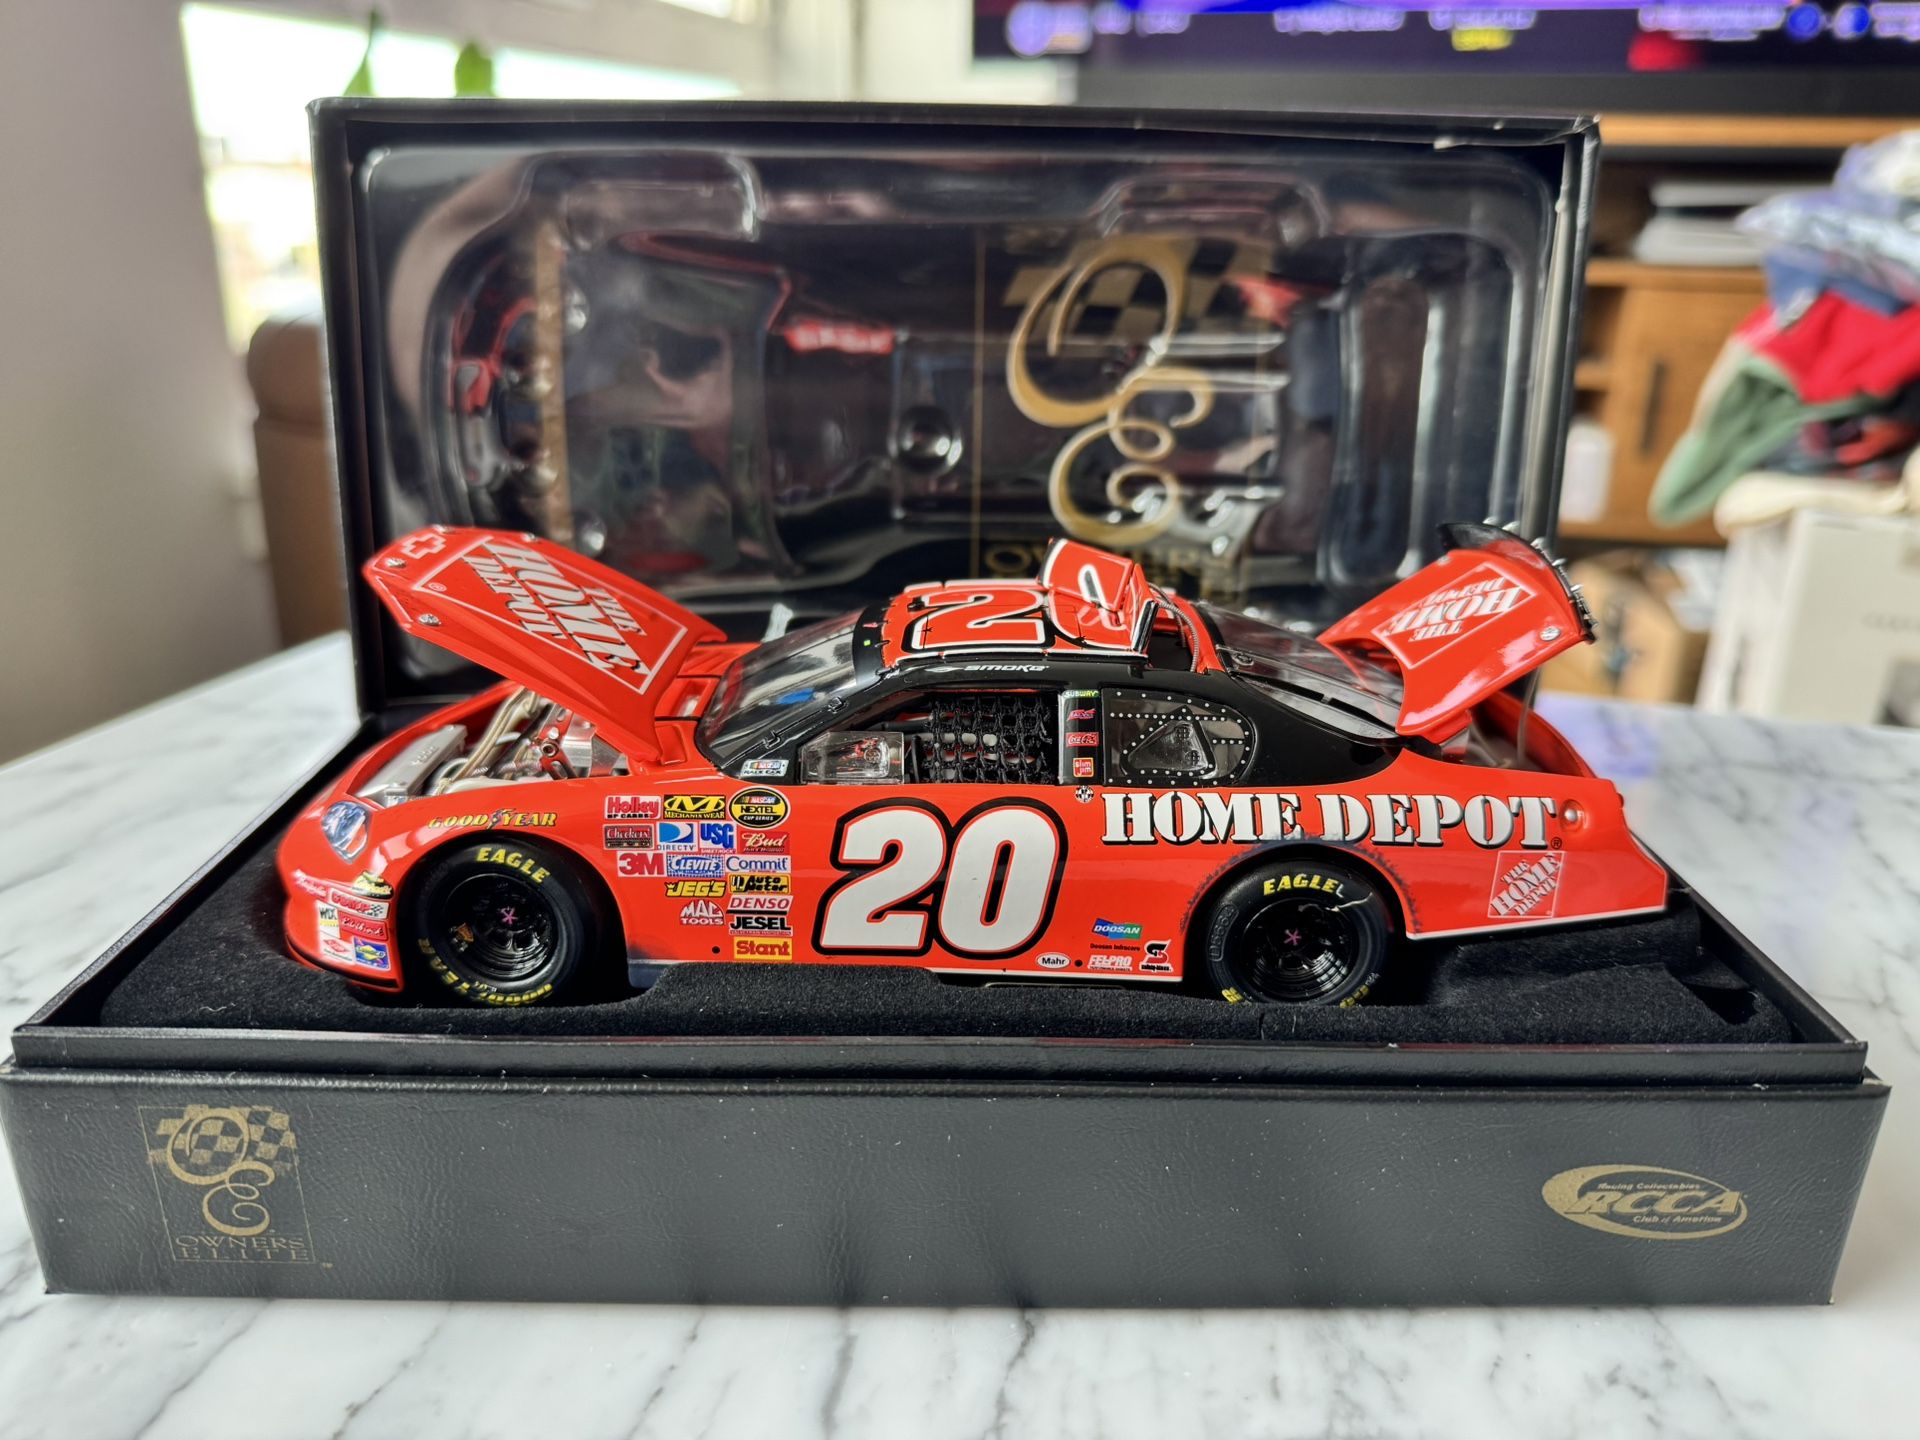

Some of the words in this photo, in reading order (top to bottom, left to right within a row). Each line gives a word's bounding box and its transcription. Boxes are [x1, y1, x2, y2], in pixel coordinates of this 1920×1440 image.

[482, 542, 651, 677] HOME
[1384, 586, 1525, 637] HOME
[1065, 690, 1099, 698] SUBWAY
[607, 796, 659, 818] Holley
[703, 810, 725, 819] WEAR
[740, 805, 778, 814] NEXTEL
[1100, 792, 1304, 845] HOME
[1316, 793, 1557, 849] DEPOT
[700, 823, 734, 849] USG
[742, 832, 787, 847] Bud
[475, 847, 551, 884] EAGLE
[619, 853, 664, 875] 3M
[671, 856, 718, 871] CLEVITE
[726, 856, 788, 872] Commit
[747, 875, 781, 884] Auto
[812, 797, 1068, 960] 20
[1500, 859, 1530, 885] THE
[666, 881, 727, 898] JEG'S
[1262, 873, 1340, 896] EAGLE
[1490, 852, 1561, 916] HOME
[680, 899, 723, 918] MAC
[729, 897, 790, 910] DENSO
[681, 917, 724, 925] TOOLS
[730, 916, 792, 931] JESEL
[1092, 925, 1140, 934] DOOSAN
[736, 940, 790, 956] Stant
[1041, 956, 1066, 965] Mahr
[1563, 1191, 1742, 1214] RCCA
[1633, 1215, 1660, 1223] Club
[175, 1235, 306, 1250] OWNERS
